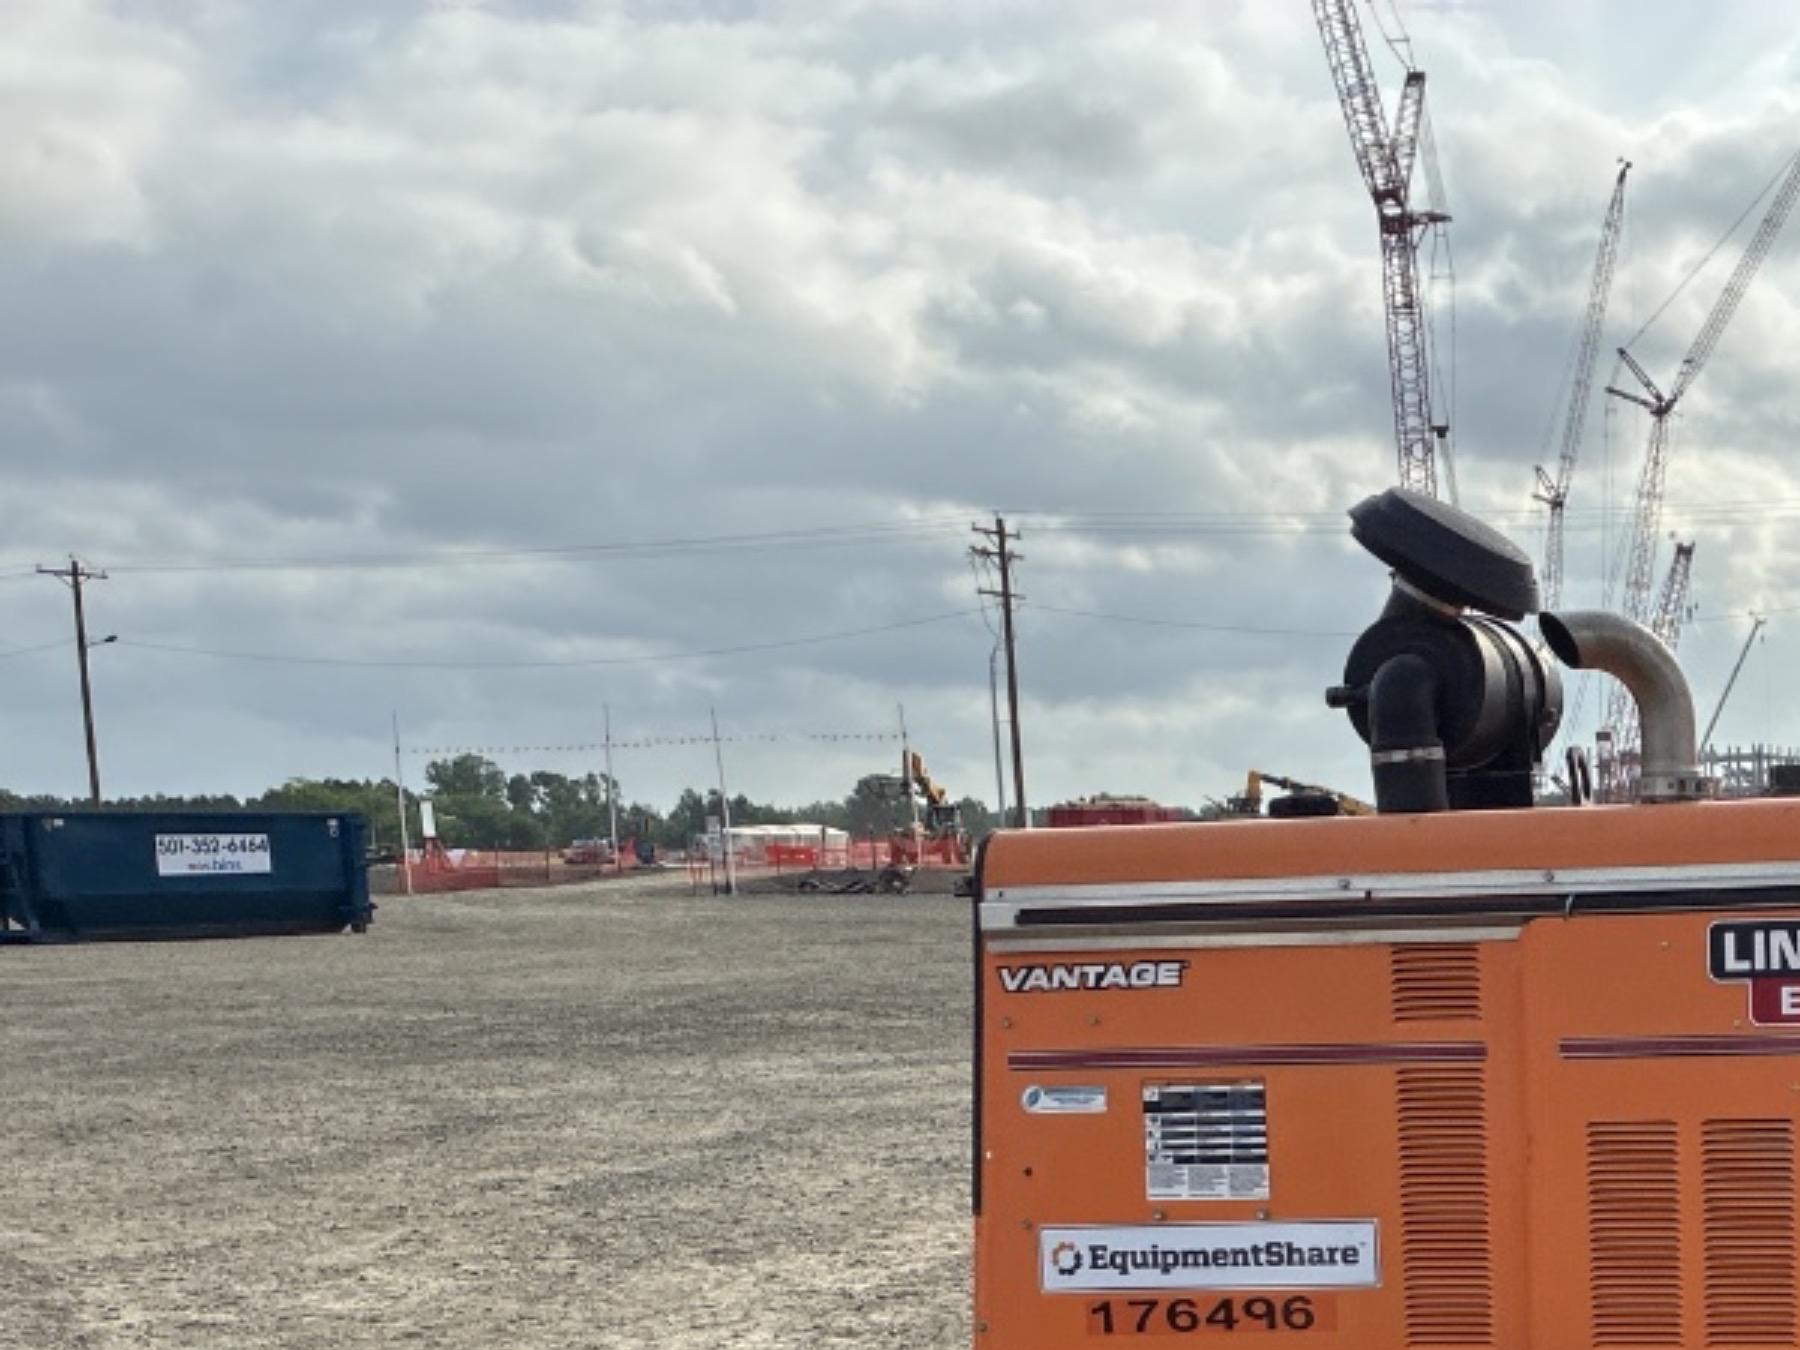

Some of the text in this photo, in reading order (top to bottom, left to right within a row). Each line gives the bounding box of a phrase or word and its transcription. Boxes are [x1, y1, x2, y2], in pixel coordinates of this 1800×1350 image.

[1000, 962, 1183, 991] VANTAGE
[1088, 1240, 1361, 1276] EquipmentShare
[1091, 1296, 1315, 1334] 176496
